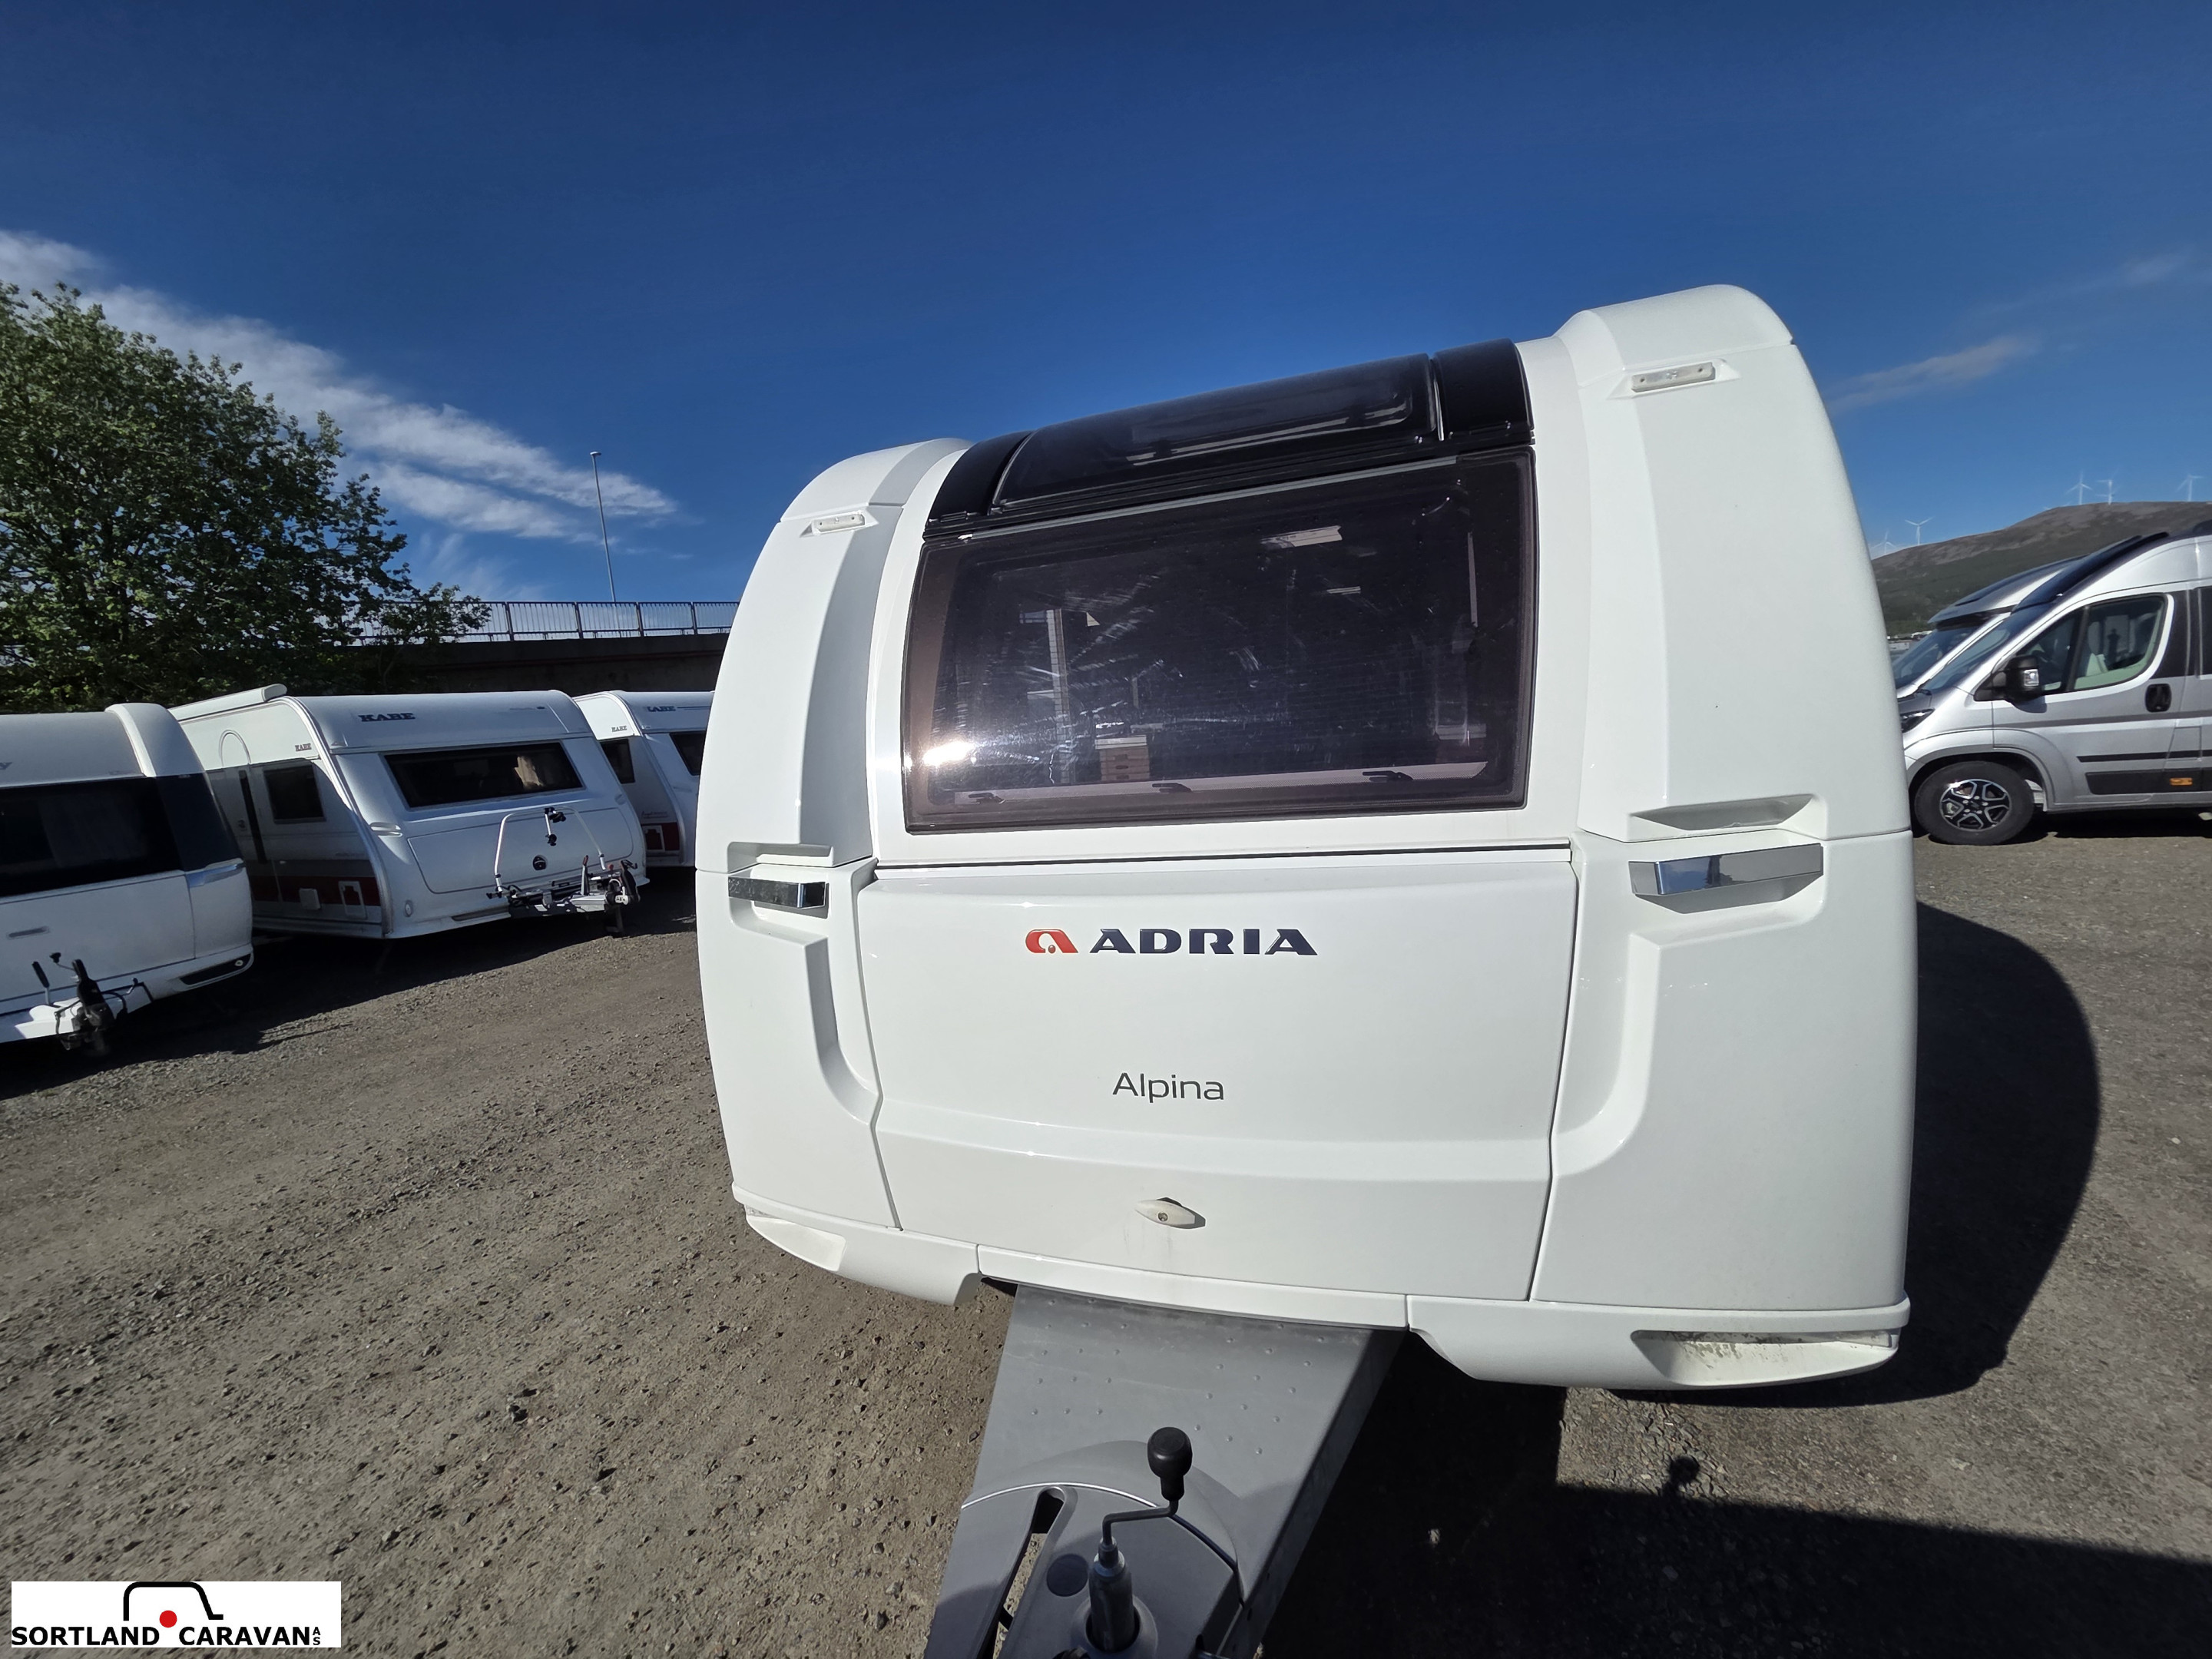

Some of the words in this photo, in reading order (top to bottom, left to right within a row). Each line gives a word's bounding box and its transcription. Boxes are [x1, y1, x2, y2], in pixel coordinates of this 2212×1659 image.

[358, 713, 416, 722] KABE
[295, 743, 312, 752] KABE
[1089, 929, 1318, 955] ADRIA
[1112, 1072, 1224, 1103] Alpina
